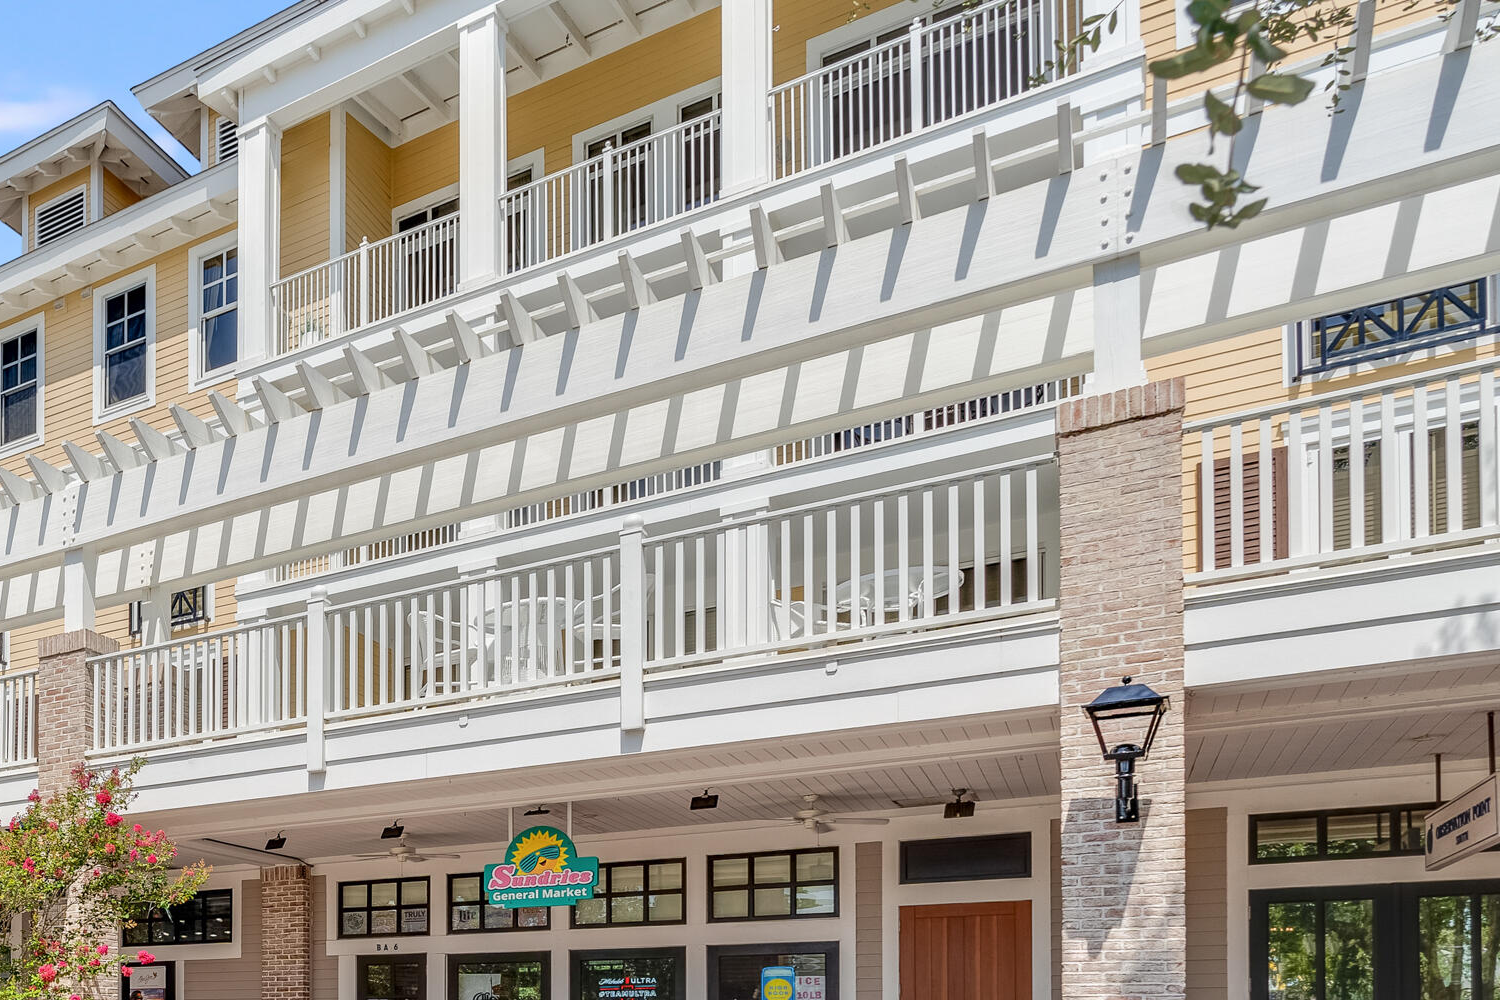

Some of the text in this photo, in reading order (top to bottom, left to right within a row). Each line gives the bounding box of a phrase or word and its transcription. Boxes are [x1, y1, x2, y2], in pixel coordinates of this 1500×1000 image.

[1472, 797, 1491, 820] POINT
[488, 865, 593, 890] Sundries
[493, 887, 588, 901] General Market
[404, 910, 426, 918] TRULY
[459, 910, 477, 922] Lite
[799, 977, 821, 985] ICE
